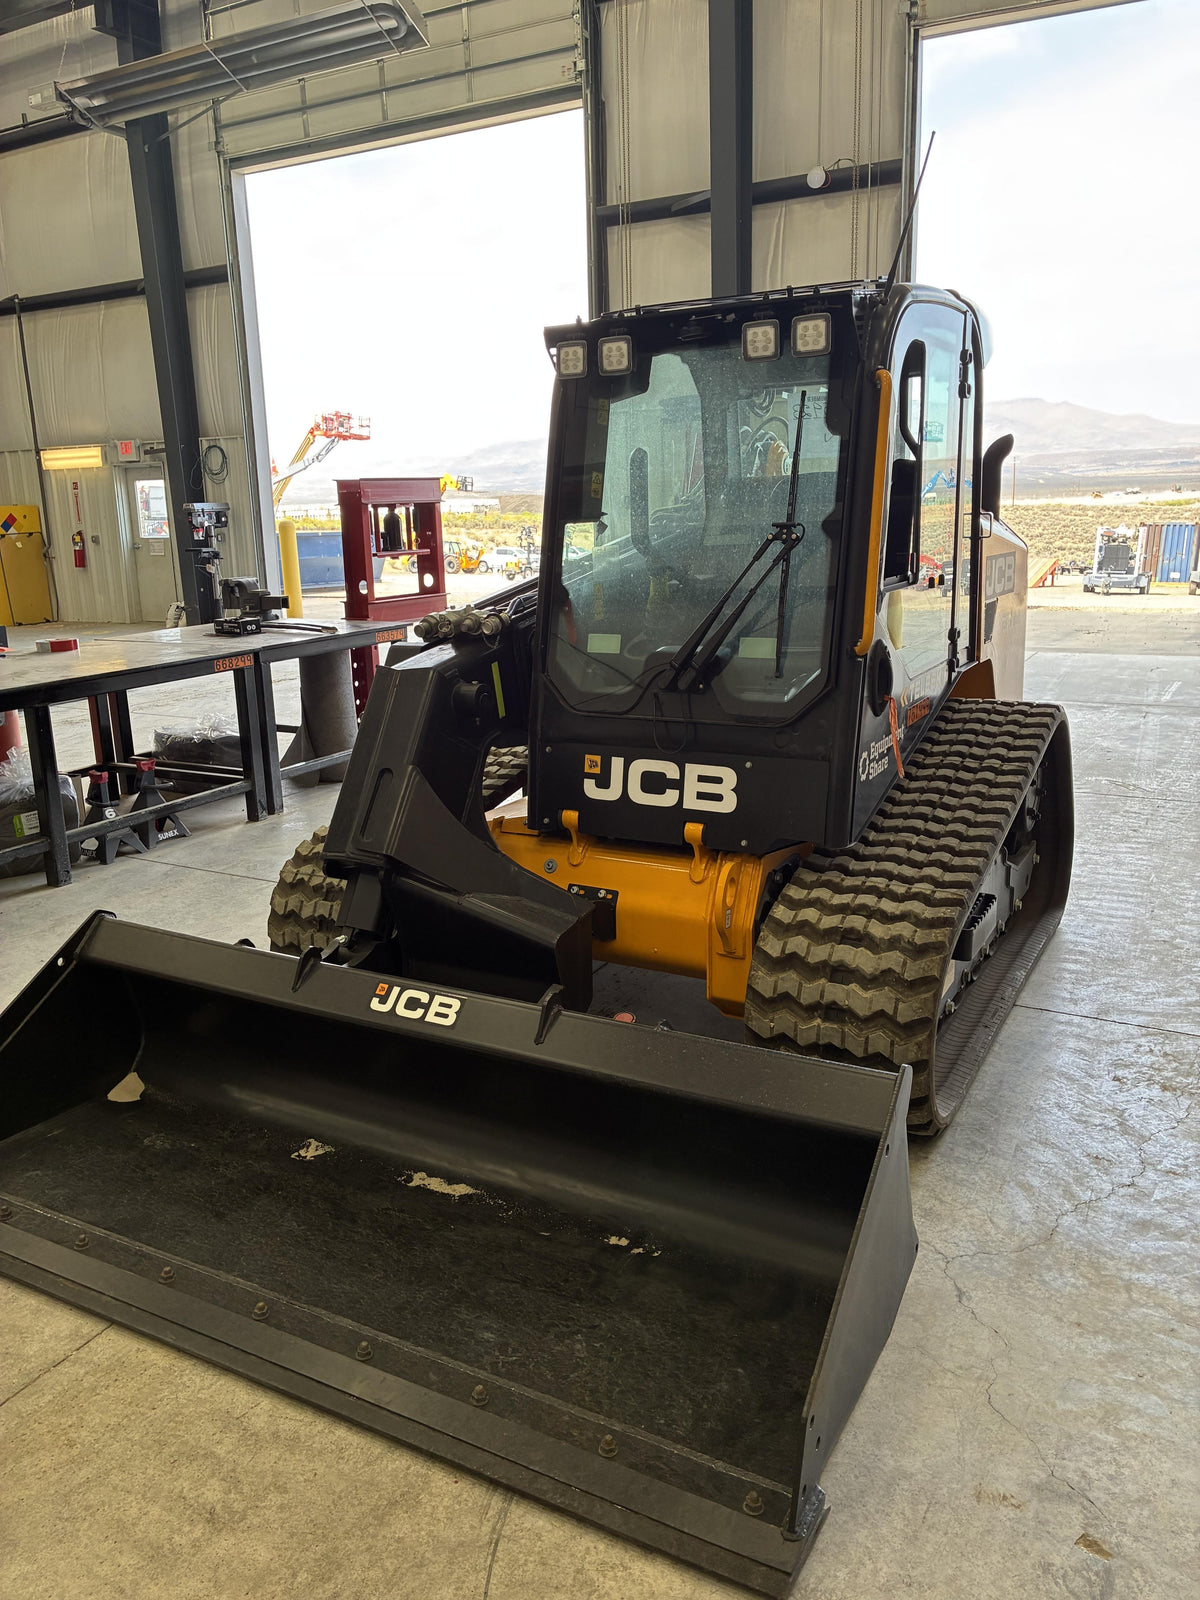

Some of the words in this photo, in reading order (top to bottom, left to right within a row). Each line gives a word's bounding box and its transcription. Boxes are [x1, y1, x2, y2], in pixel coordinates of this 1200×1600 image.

[120, 441, 132, 455] EXIT
[986, 555, 1015, 595] JCB
[376, 629, 404, 641] 663579
[215, 655, 253, 670] 668299
[869, 756, 889, 780] Share
[583, 756, 738, 814] JCB
[104, 808, 117, 819] 6
[157, 829, 180, 841] SUNEX
[82, 850, 97, 858] UNEX
[370, 986, 461, 1026] JCB
